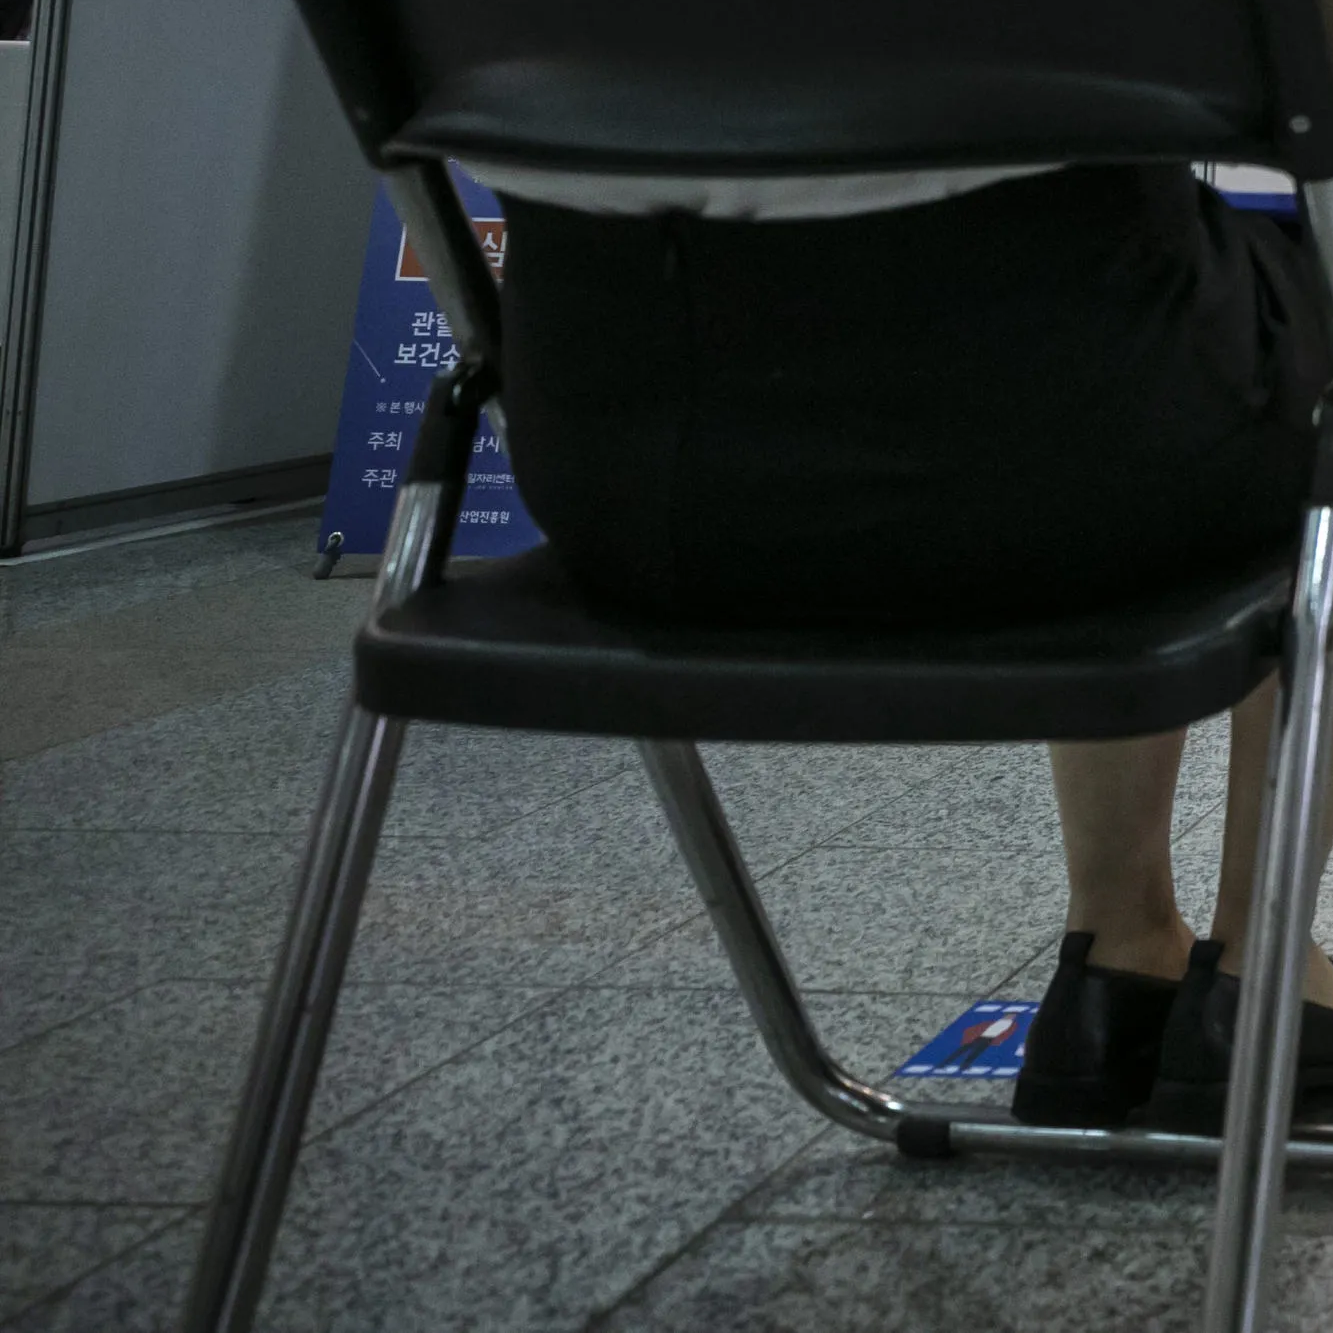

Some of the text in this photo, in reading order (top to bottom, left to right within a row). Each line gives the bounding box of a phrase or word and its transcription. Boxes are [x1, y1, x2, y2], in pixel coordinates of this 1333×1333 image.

[394, 342, 461, 368] 보건소
[367, 431, 403, 451] 주최
[361, 468, 398, 488] 주관
